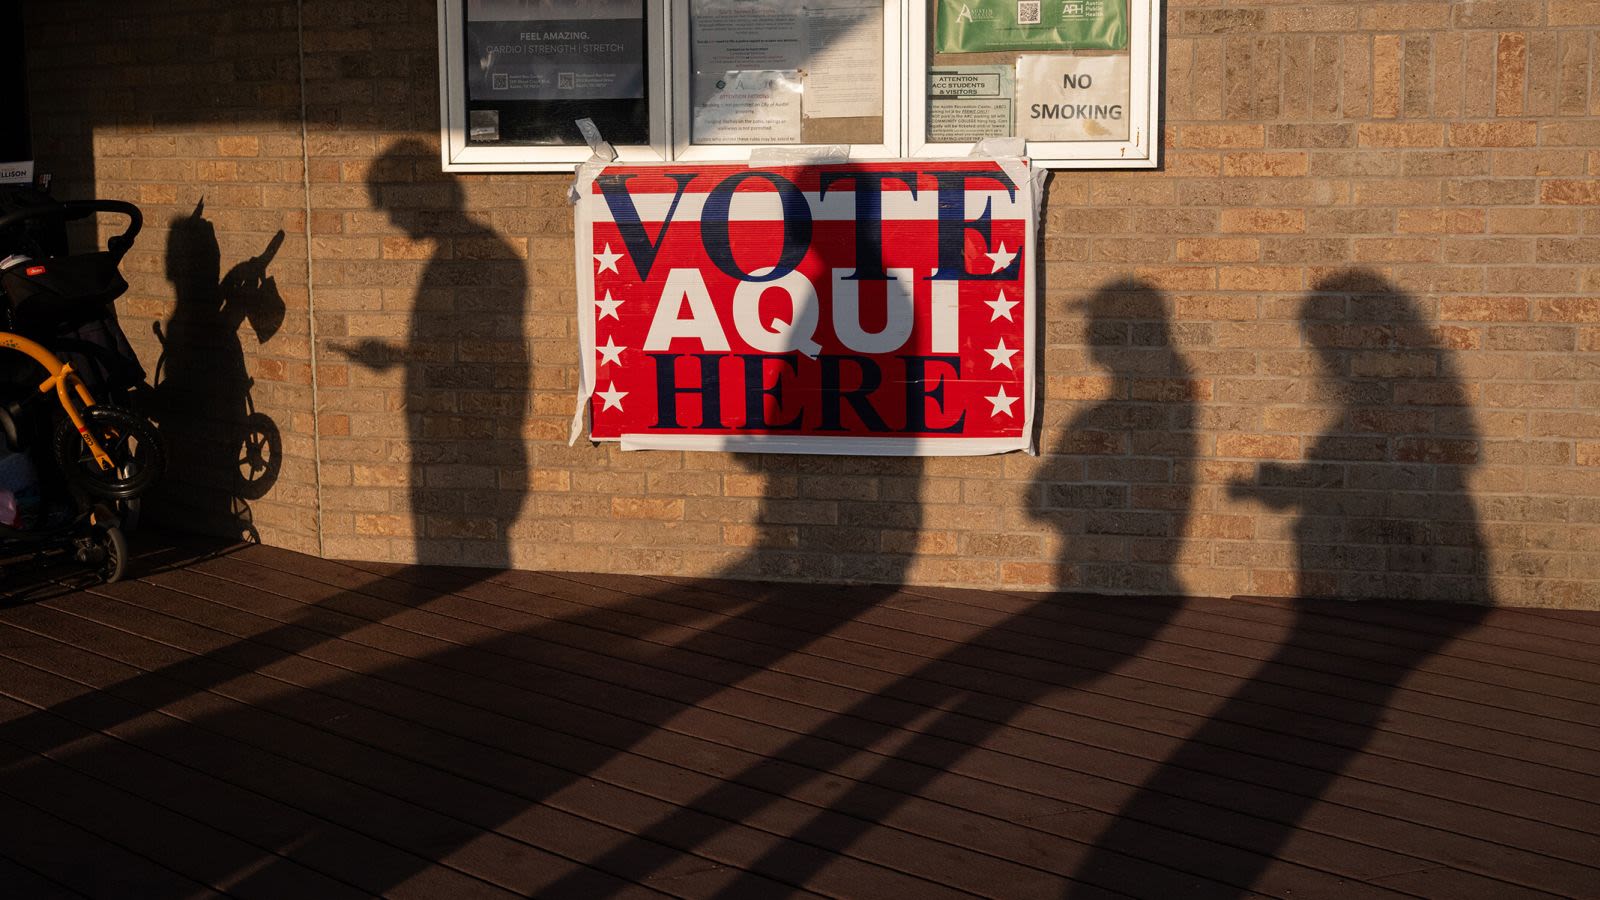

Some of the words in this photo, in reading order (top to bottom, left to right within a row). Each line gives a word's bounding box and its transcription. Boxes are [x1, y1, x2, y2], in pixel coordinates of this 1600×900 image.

[1062, 4, 1083, 14] APH
[520, 32, 541, 41] FEEL
[543, 31, 590, 40] AMAZING.
[487, 45, 521, 54] CARDIO
[528, 44, 576, 53] STRENGTH
[583, 43, 624, 52] STRETCH
[1063, 73, 1092, 90] NO
[1030, 103, 1122, 120] SMOKING
[592, 171, 1024, 283] VOTE
[642, 266, 959, 360] AQUI
[645, 353, 967, 434] HERE
